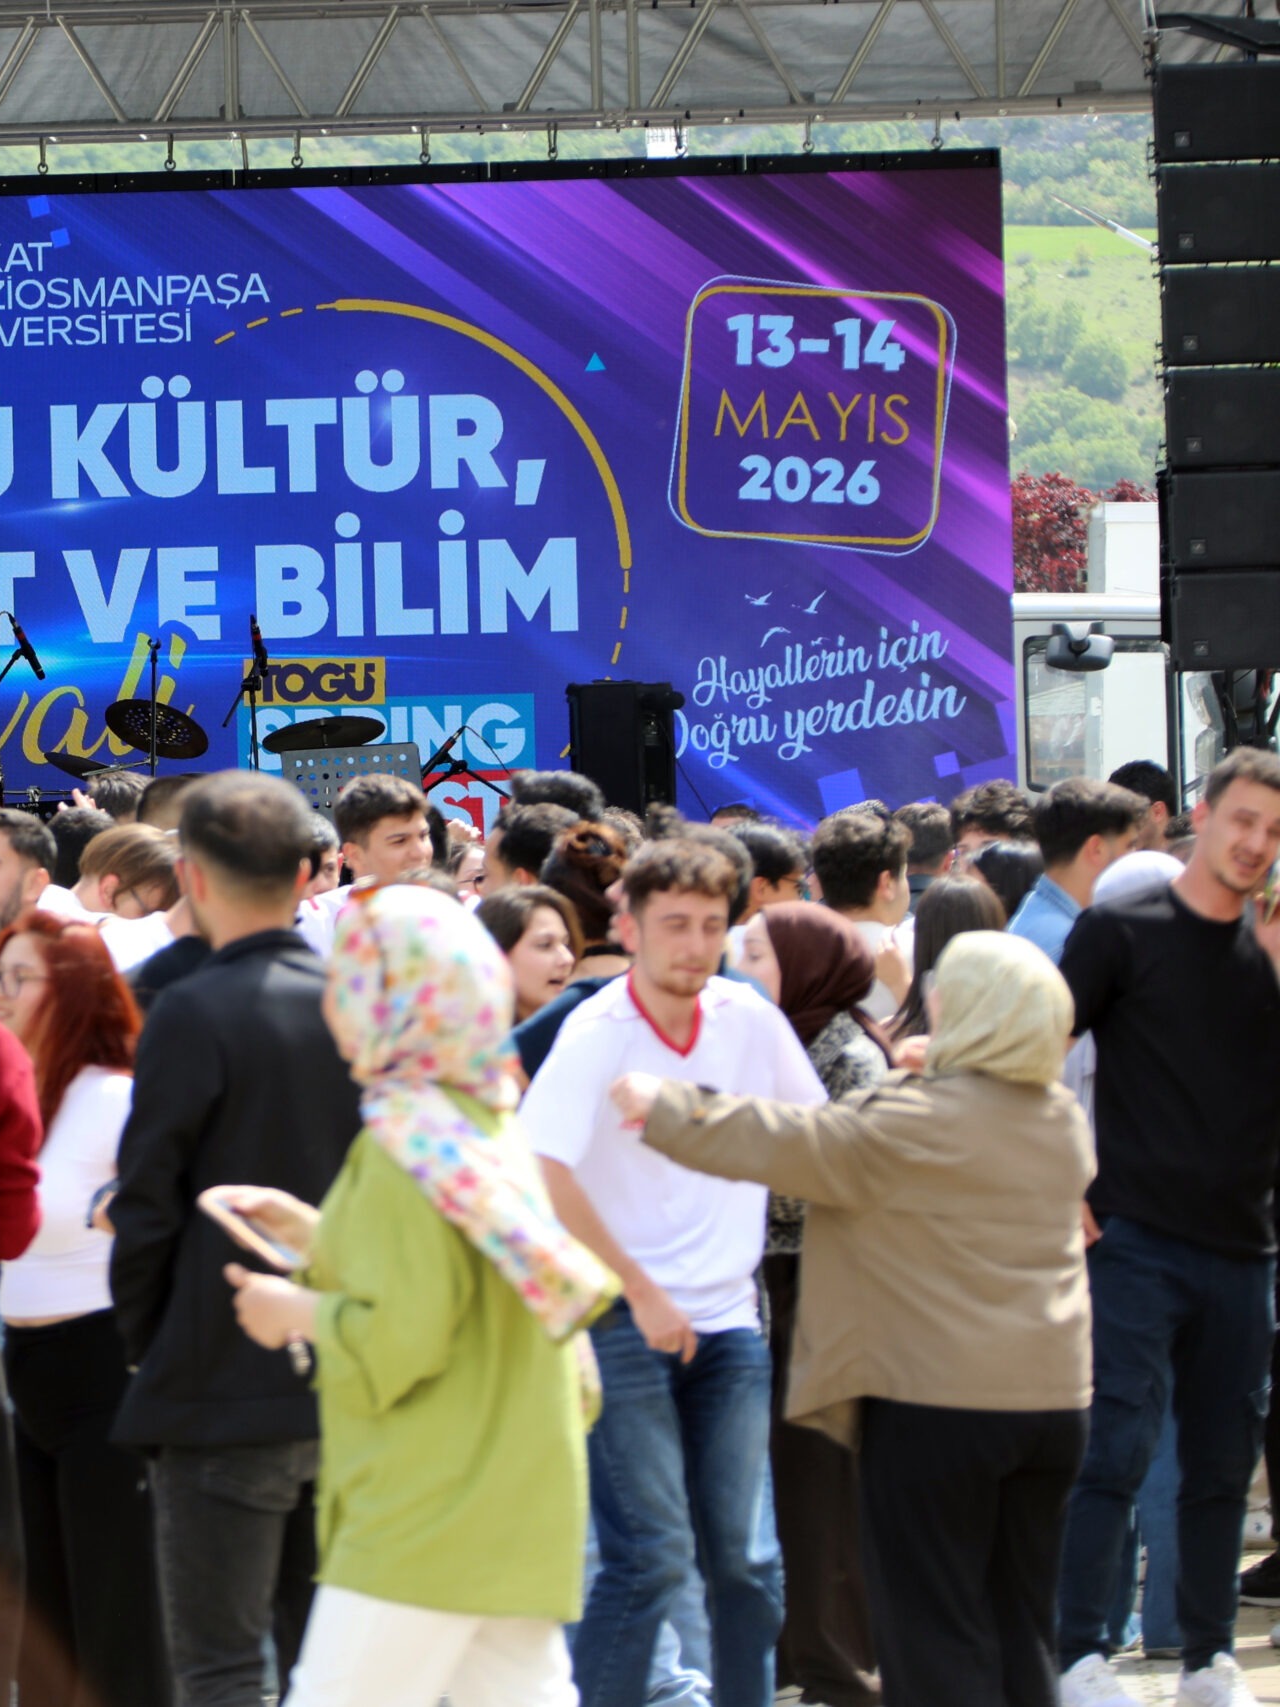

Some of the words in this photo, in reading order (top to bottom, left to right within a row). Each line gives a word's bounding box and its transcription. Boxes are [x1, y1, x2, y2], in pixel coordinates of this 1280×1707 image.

[726, 313, 906, 372] 13-14
[50, 369, 546, 506] KÜLTÜR,
[714, 388, 910, 445] MAYIS
[738, 454, 881, 506] 2026
[62, 546, 221, 644] VE
[254, 509, 579, 639] BİLİM
[692, 635, 873, 710] Hayallerin
[877, 619, 949, 673] için
[777, 672, 967, 761] yerdesin
